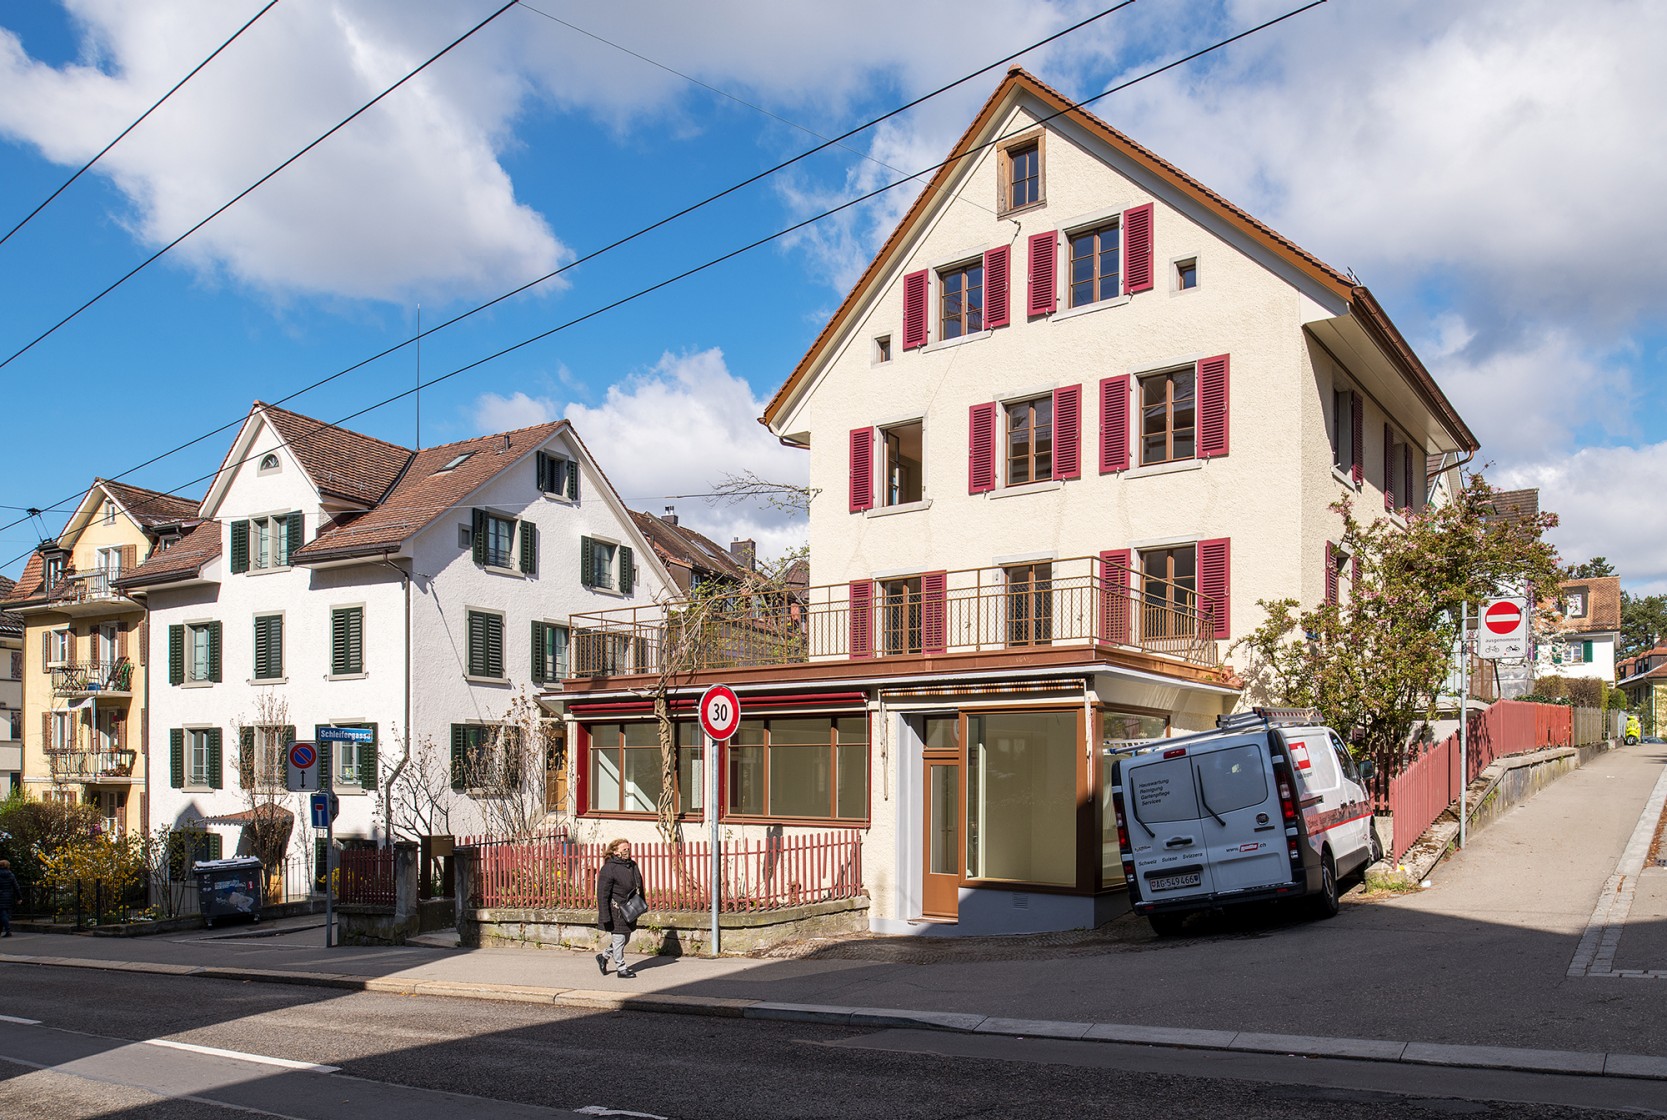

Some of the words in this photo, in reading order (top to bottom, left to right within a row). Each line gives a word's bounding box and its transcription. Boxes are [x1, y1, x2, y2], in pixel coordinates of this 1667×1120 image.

[713, 703, 727, 721] 30
[1139, 779, 1169, 788] Hauswartung
[1140, 786, 1163, 794] Reinigung
[1141, 791, 1170, 800] Gartenpflege
